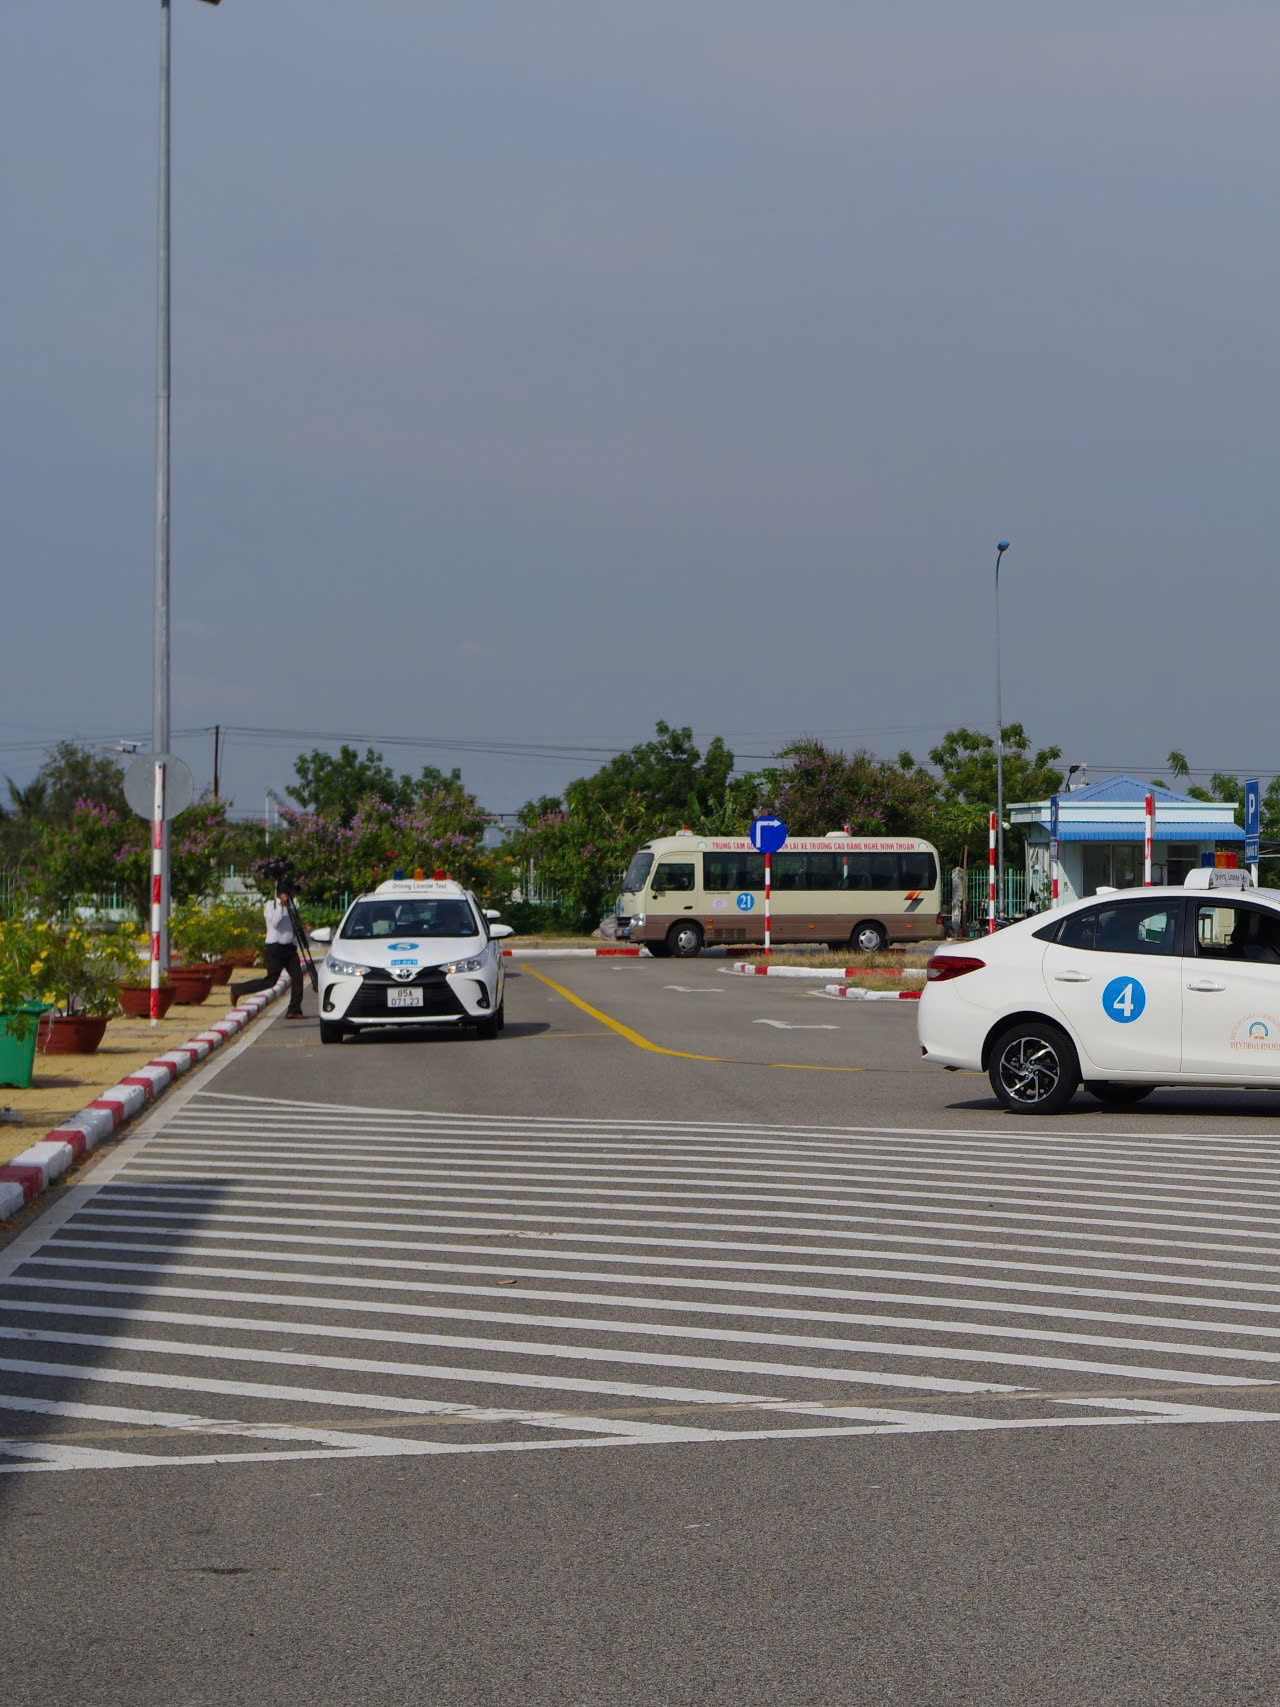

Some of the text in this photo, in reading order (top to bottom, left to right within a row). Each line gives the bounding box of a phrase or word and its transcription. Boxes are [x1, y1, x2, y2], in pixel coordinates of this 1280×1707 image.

[1248, 793, 1256, 825] P
[712, 842, 732, 850] TRUNG
[800, 842, 808, 850] XE
[880, 842, 894, 850] NINH
[740, 894, 751, 909] 21
[397, 989, 413, 998] 85A
[1113, 983, 1134, 1017] 4
